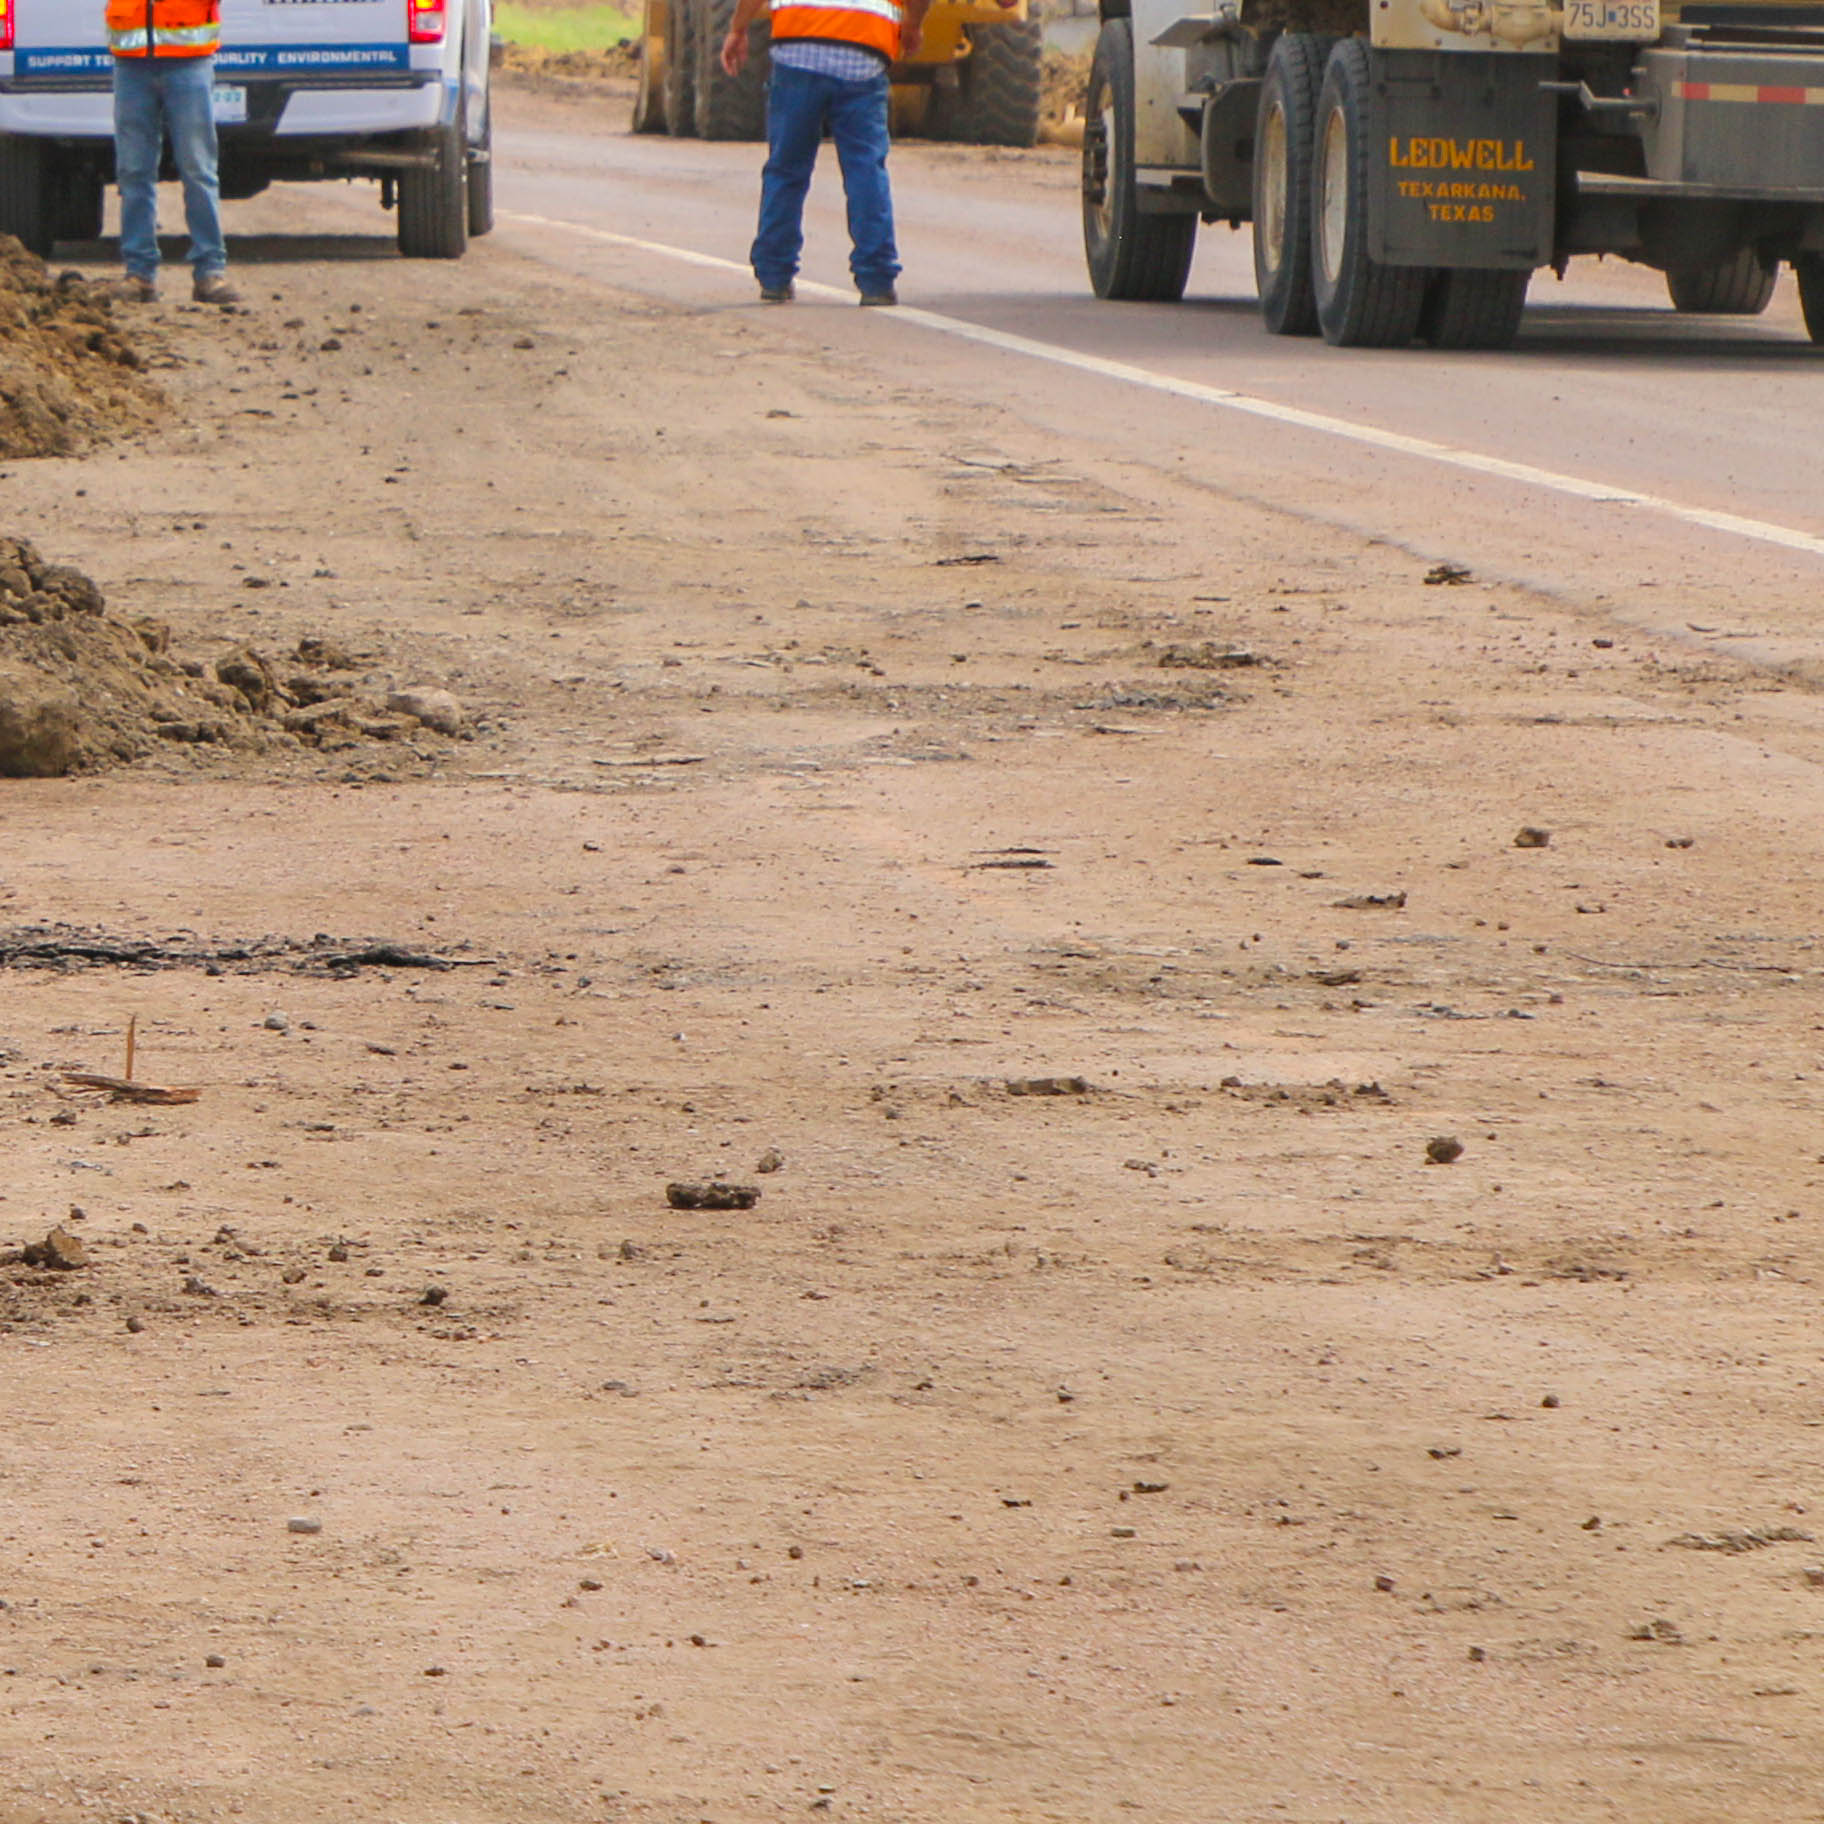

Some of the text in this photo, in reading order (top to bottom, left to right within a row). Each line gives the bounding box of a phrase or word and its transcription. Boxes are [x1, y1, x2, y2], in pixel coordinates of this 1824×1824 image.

[28, 55, 91, 67] SUPPORT
[278, 50, 397, 64] ENVIRONMENTAL
[1390, 136, 1536, 171] LEDWELL
[1429, 204, 1495, 222] TEXAS
